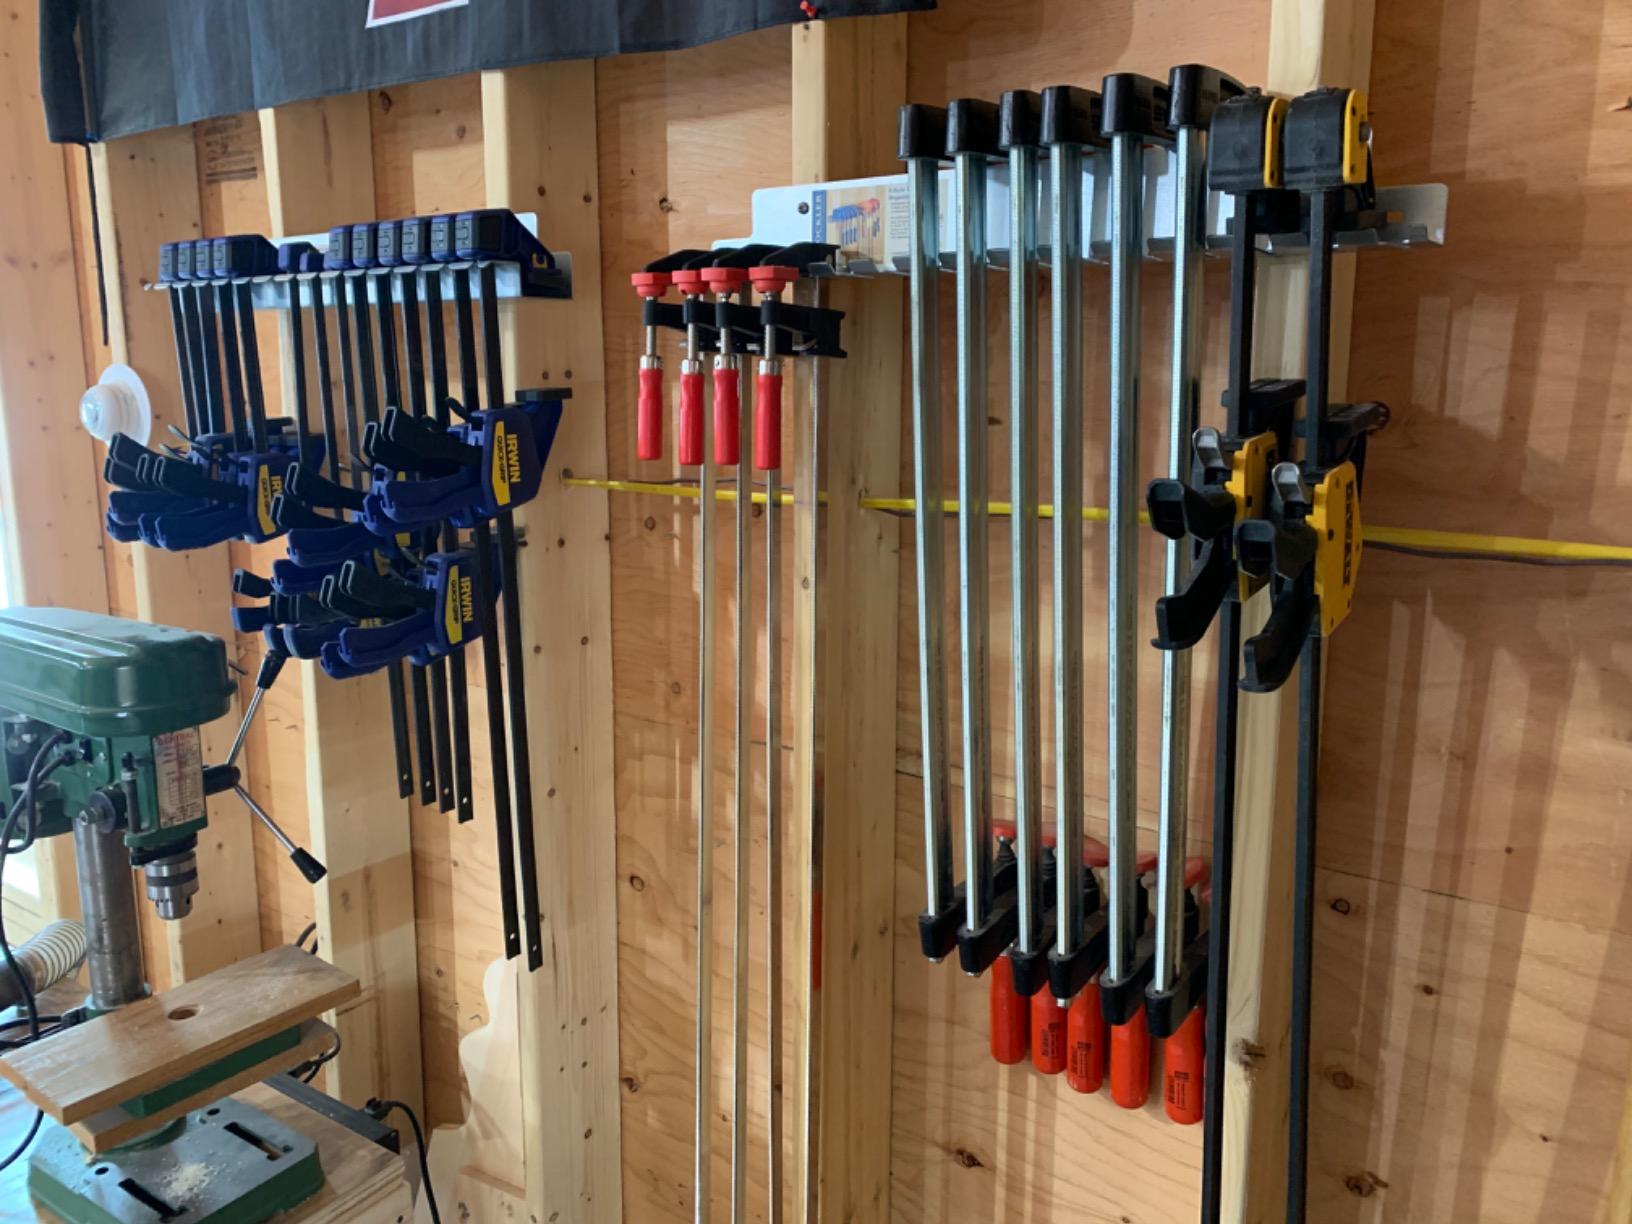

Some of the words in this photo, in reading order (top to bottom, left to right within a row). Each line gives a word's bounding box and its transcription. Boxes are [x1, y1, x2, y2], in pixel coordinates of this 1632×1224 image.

[815, 194, 823, 243] OCKLER
[507, 433, 521, 482] IRWIN
[460, 577, 473, 622] IRWIN
